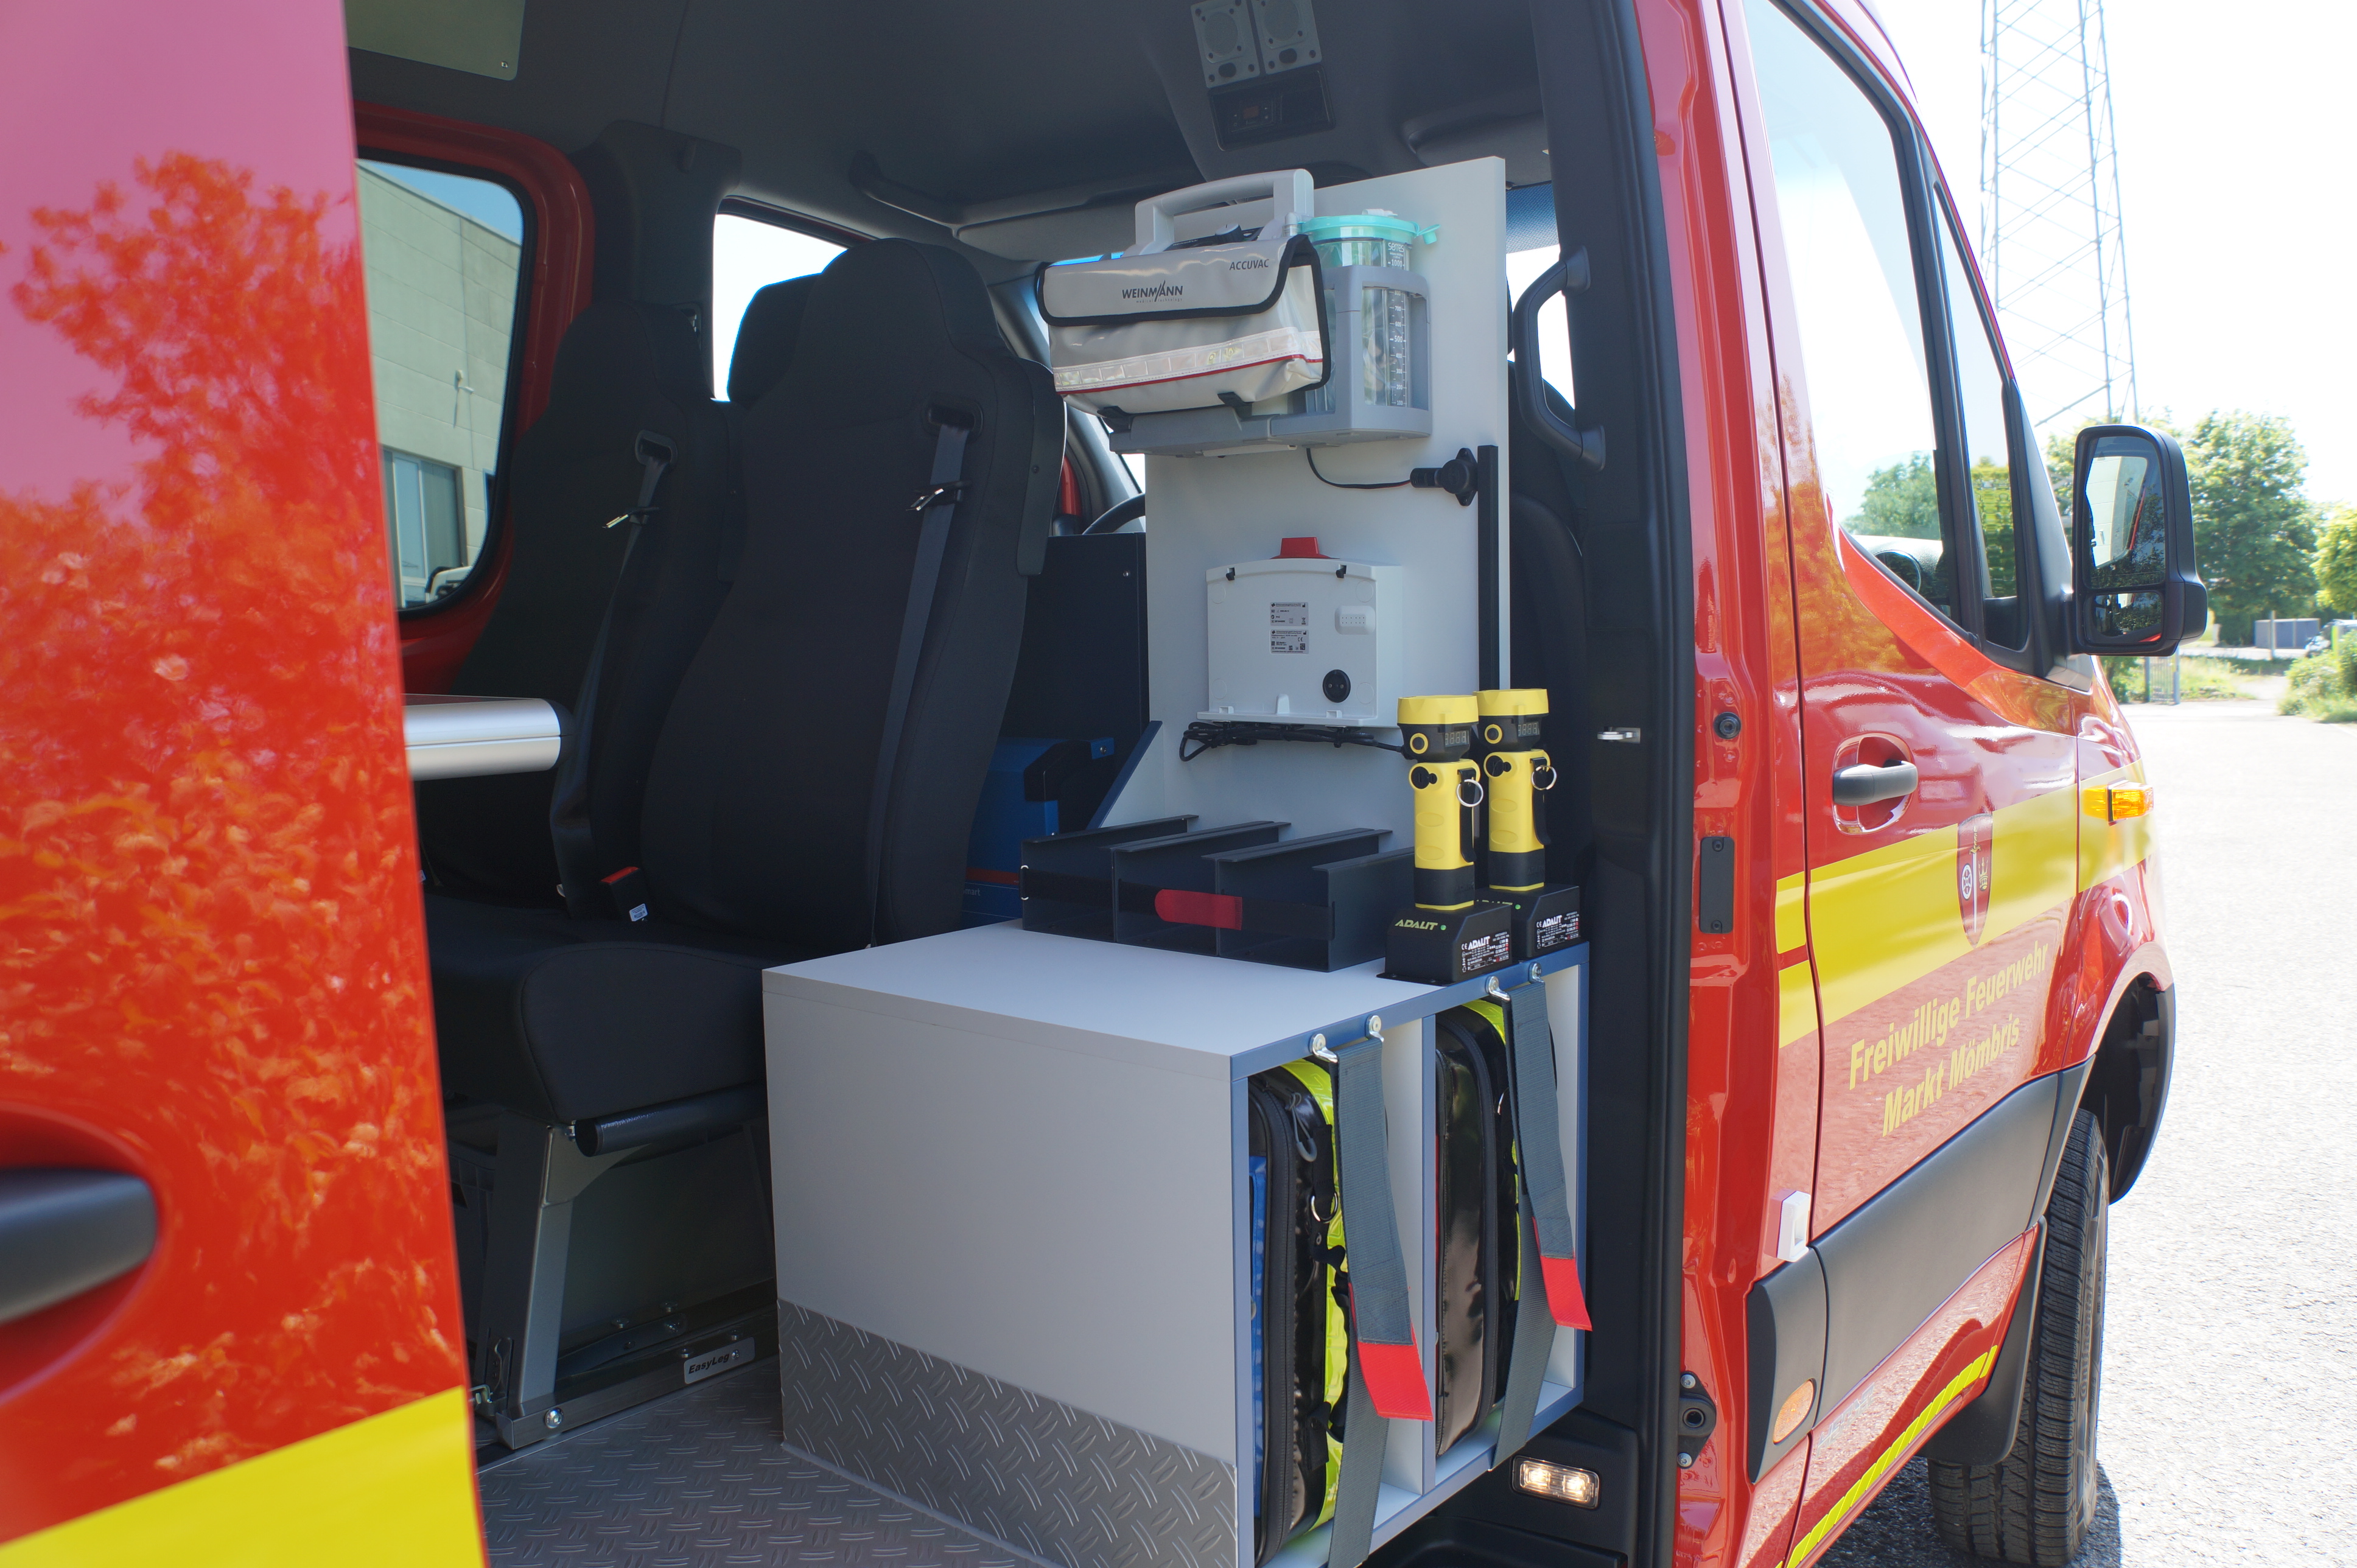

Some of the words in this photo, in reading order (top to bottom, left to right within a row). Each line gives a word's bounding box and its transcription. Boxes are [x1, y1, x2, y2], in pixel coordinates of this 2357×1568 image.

[1388, 242, 1404, 253] serres
[1229, 259, 1270, 271] ACCUVAC
[1122, 281, 1183, 302] WEINMANN
[1395, 919, 1438, 931] ADALIT
[1542, 915, 1562, 928] ADALIT
[1468, 936, 1490, 950] ADALIT
[1849, 997, 1959, 1090] Freiwillige
[1966, 940, 2048, 1019] Feuerwehr
[1882, 1059, 1944, 1137] Markt
[1948, 1013, 2020, 1091] Mömbris
[688, 1353, 730, 1374] EasyLeg
